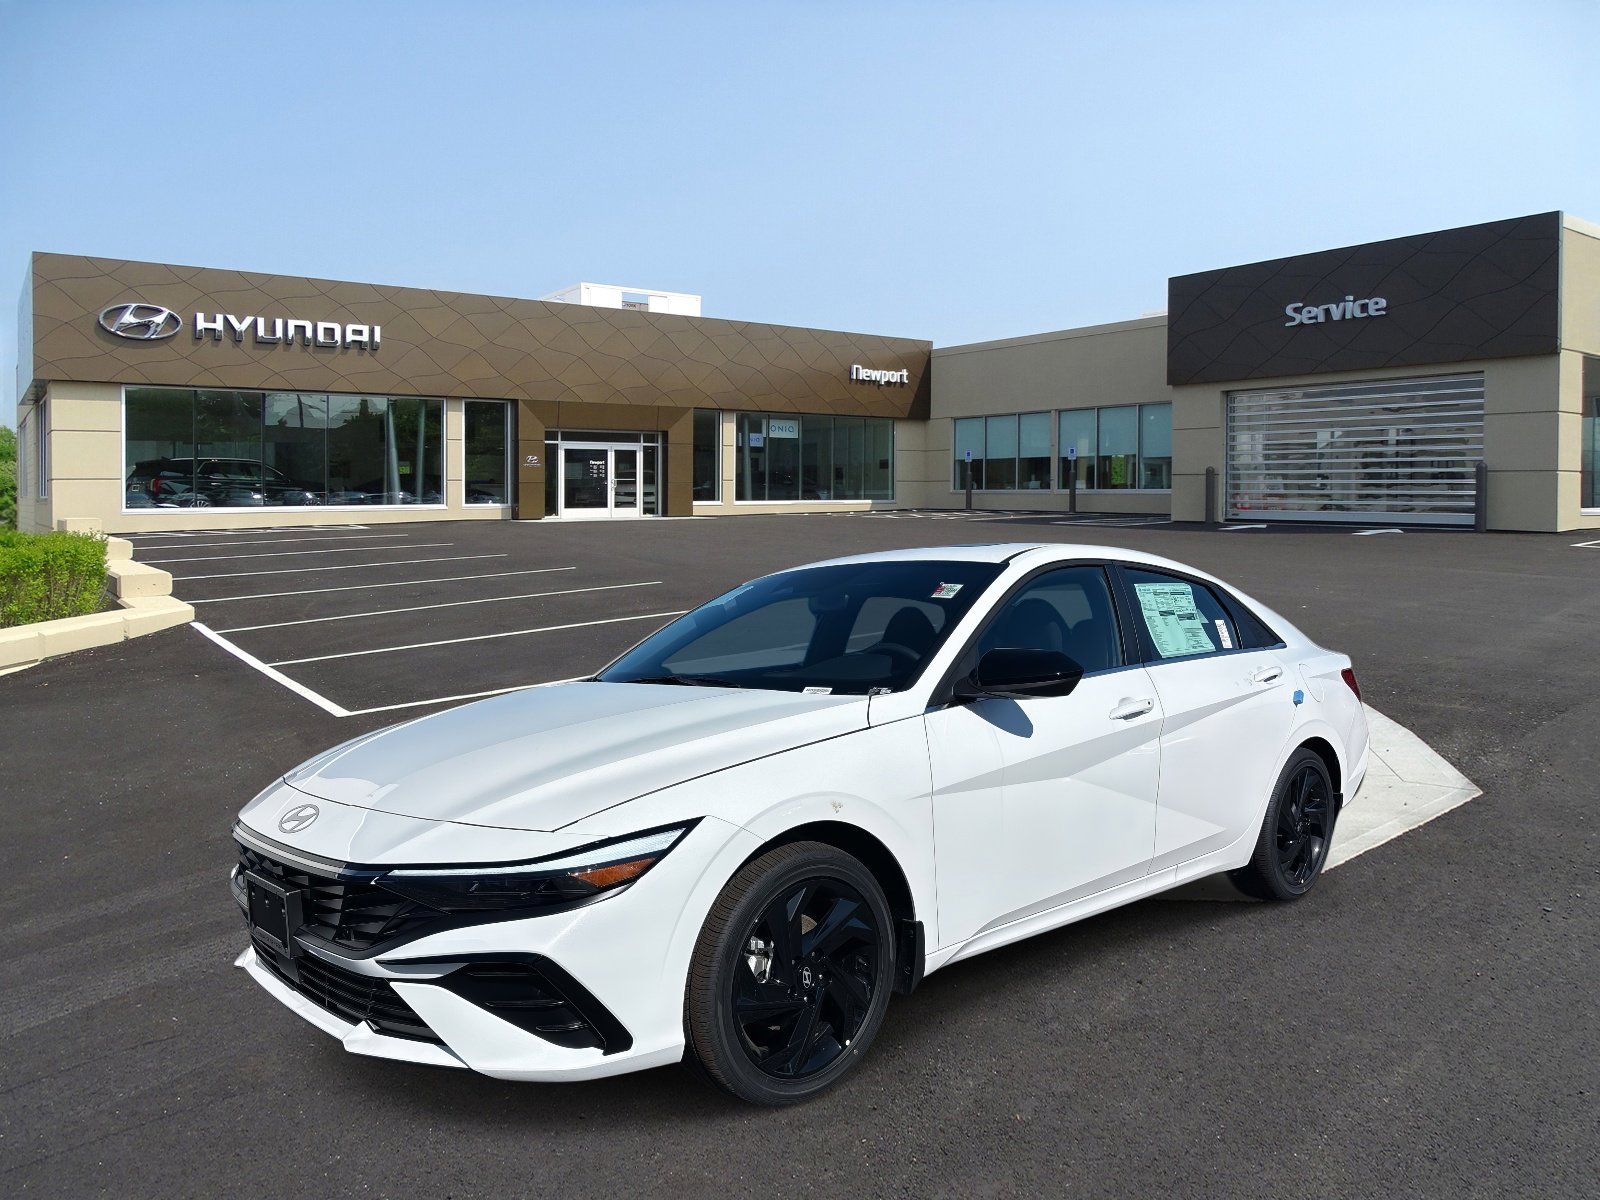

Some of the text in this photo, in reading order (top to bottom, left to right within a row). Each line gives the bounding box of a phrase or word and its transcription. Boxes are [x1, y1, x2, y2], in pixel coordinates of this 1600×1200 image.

[1284, 295, 1387, 326] Service
[194, 312, 381, 350] HYUNDAI
[850, 364, 909, 385] Newport
